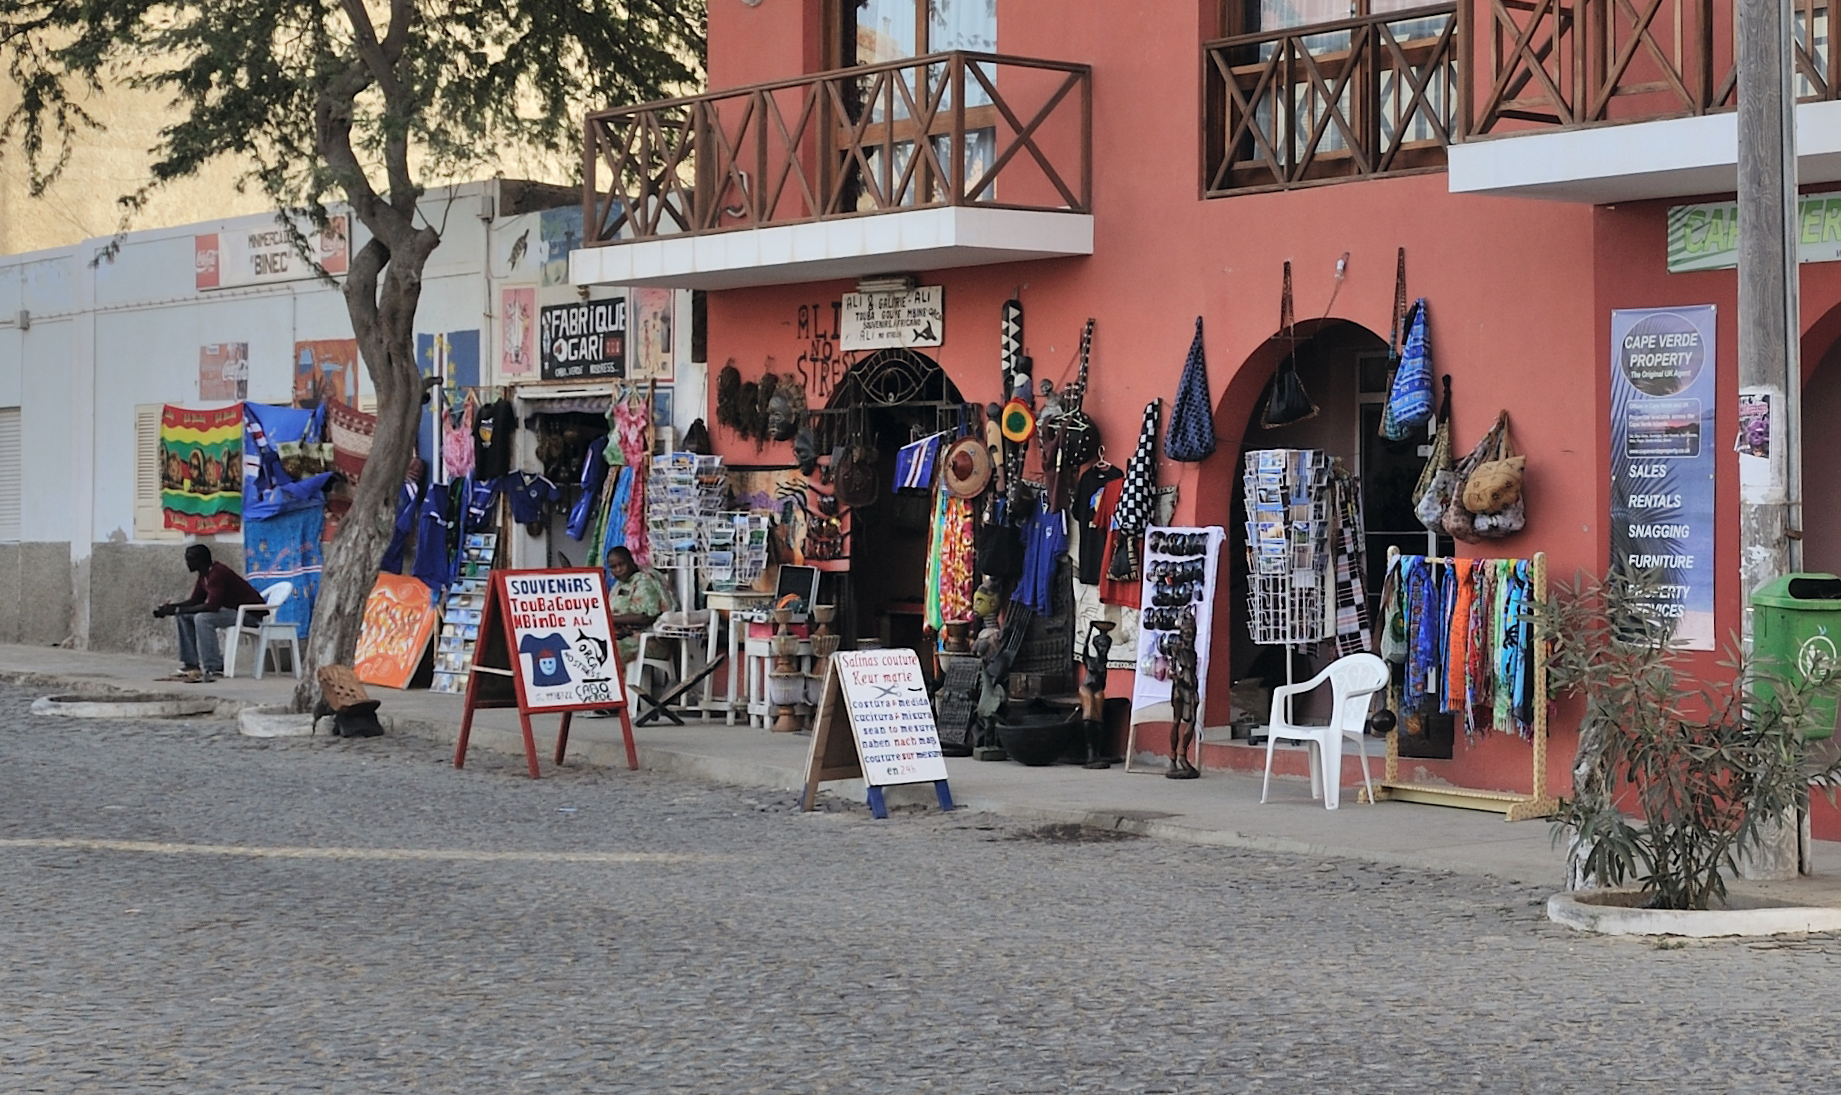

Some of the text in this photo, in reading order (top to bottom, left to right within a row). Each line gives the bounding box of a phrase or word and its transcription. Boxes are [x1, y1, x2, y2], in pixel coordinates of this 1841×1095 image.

[797, 301, 842, 340] ALI
[1624, 333, 1698, 349] CAPE VERDE
[1630, 352, 1692, 367] PROPERTY
[1629, 464, 1667, 478] SALES
[1628, 494, 1682, 508] RENTALS
[1628, 524, 1690, 539] SNAGGING
[1628, 555, 1694, 569] FURNITURE
